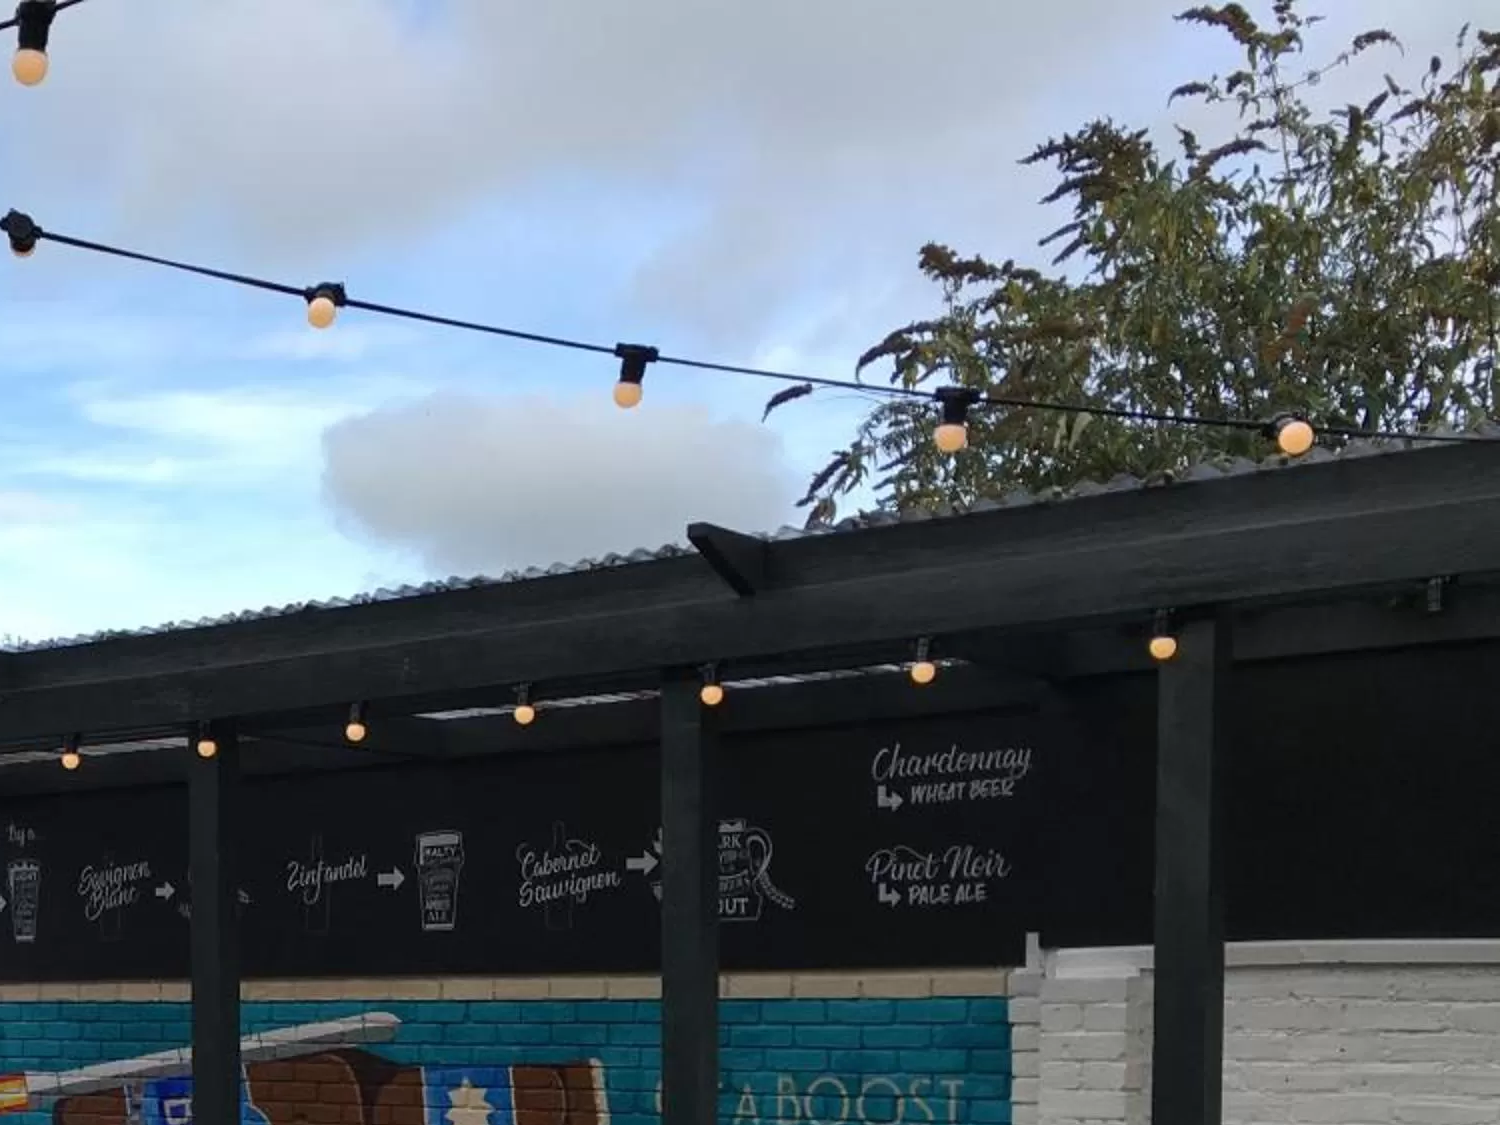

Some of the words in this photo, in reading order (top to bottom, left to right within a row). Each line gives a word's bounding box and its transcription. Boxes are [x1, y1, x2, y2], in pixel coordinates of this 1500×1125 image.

[871, 741, 1032, 782] Chardonnay
[910, 781, 966, 804] WHEAT
[969, 778, 1015, 800] BEER
[287, 854, 368, 905] Zinfandel
[516, 840, 602, 881] Cabernet
[865, 845, 940, 883] Pinot
[943, 844, 1013, 879] Noir
[519, 871, 621, 907] Sauvignon
[907, 884, 951, 905] PALE
[954, 883, 989, 904] ALE
